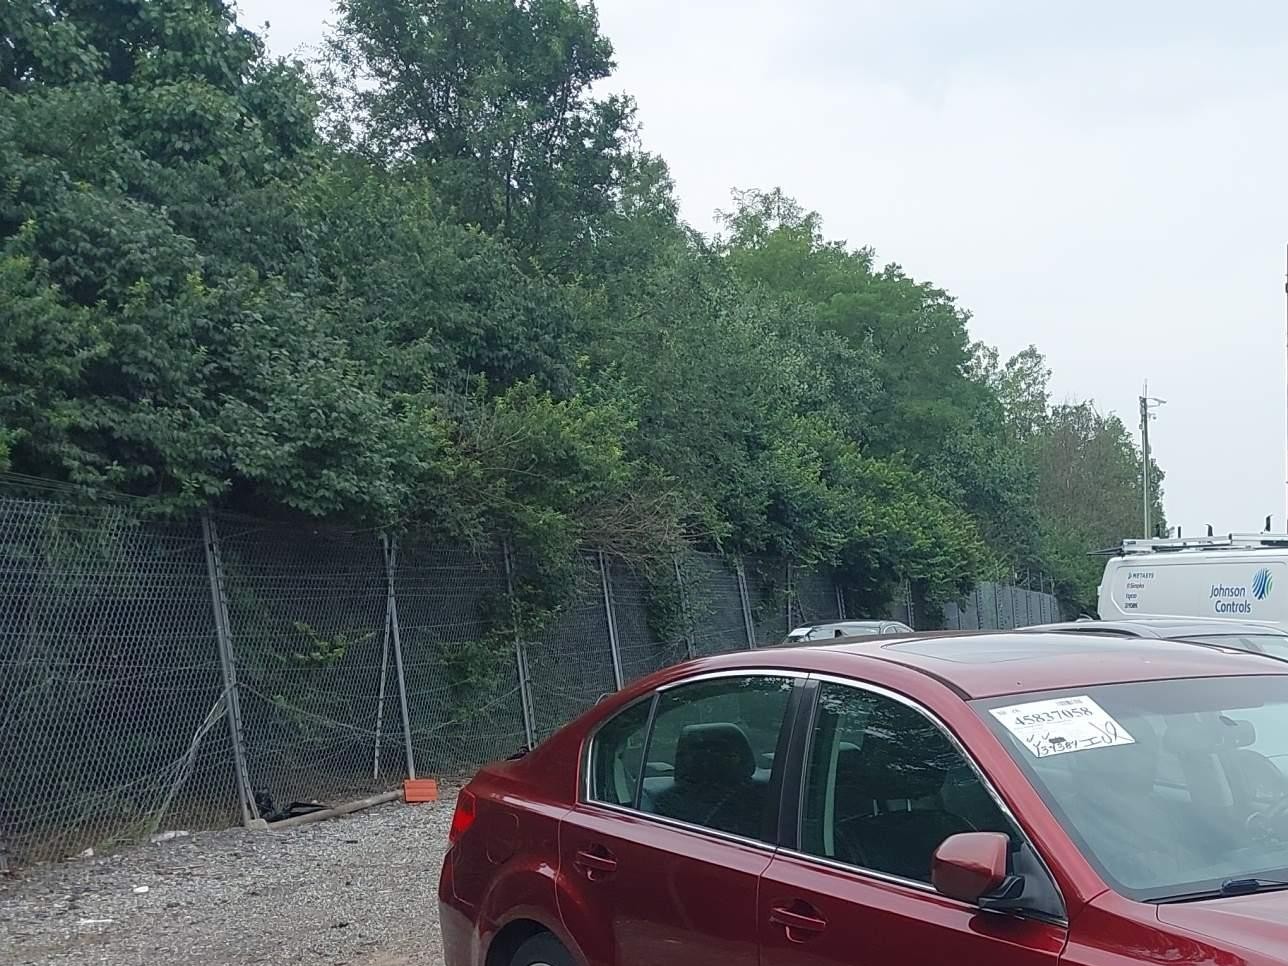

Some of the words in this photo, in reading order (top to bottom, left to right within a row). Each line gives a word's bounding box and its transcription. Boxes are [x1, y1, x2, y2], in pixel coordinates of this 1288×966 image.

[1209, 584, 1246, 599] Johnson
[1215, 600, 1251, 613] Controls
[1015, 706, 1093, 726] 45837058
